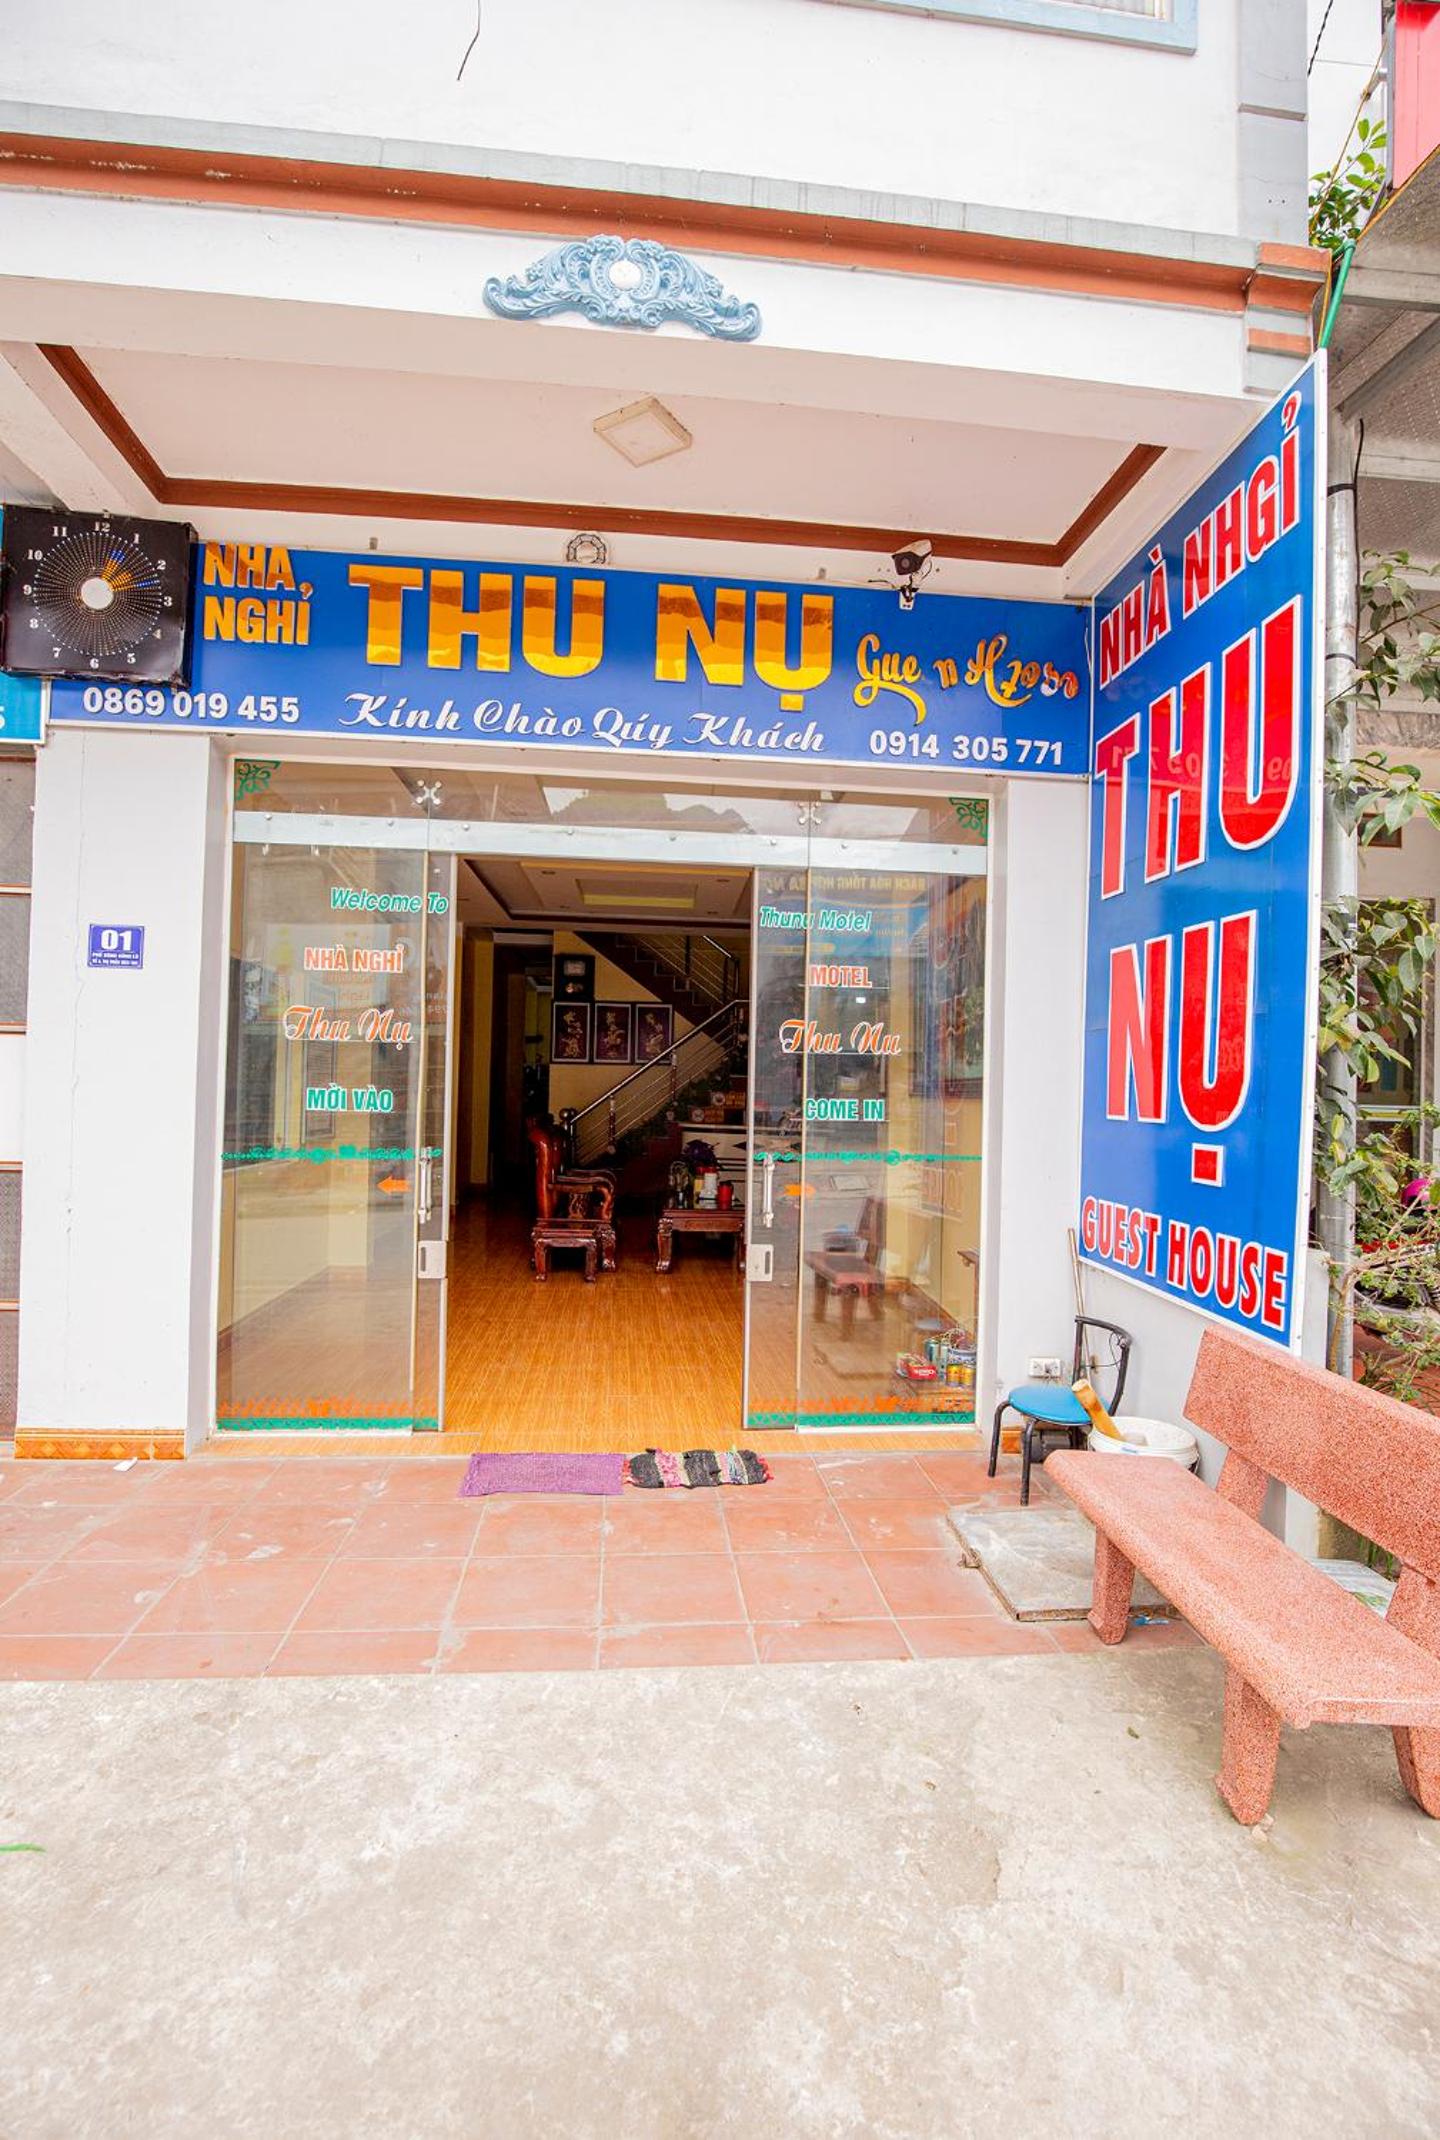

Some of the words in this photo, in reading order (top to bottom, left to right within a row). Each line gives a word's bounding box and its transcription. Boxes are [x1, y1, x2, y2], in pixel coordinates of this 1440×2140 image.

[52, 526, 67, 537] 11
[94, 522, 110, 533] 12
[133, 533, 140, 544] 1
[27, 549, 43, 560] 10
[157, 560, 166, 570] 2
[23, 585, 32, 595] 9
[163, 597, 172, 607] 3
[203, 582, 314, 645] NGHỈ
[29, 619, 39, 629] 8
[1100, 543, 1171, 691] NHÀ
[152, 629, 162, 640] 4
[349, 564, 605, 679] THU
[655, 583, 835, 712] NỤ
[53, 648, 62, 658] 7
[90, 658, 99, 669] 6
[127, 653, 136, 664] 5
[83, 687, 165, 717] 0869
[173, 690, 228, 720] 019
[238, 694, 300, 723] 455
[338, 693, 462, 731] Kính
[472, 700, 585, 738] Chào
[682, 712, 827, 753] Khách
[870, 730, 940, 759] 0914
[953, 735, 1008, 762] 305
[1016, 739, 1064, 765] 771
[1096, 595, 1302, 900] THU
[331, 887, 423, 913] Welcome
[427, 891, 449, 914] To
[818, 909, 872, 931] Motel
[101, 929, 132, 951] 01
[304, 944, 349, 971] NHÀ
[352, 943, 405, 973] NGHỈ
[809, 964, 872, 988] MOTEL
[284, 1005, 350, 1040] Thu
[358, 1008, 413, 1050] Nụ
[780, 1019, 842, 1053] Thu
[1105, 909, 1257, 1187] NỤ
[306, 1083, 347, 1111] MỜI
[352, 1084, 394, 1113] VÀO
[804, 1098, 859, 1121] COME
[863, 1098, 885, 1121] IN
[1081, 1195, 1162, 1277] GUEST
[1167, 1220, 1288, 1332] HOUSE
